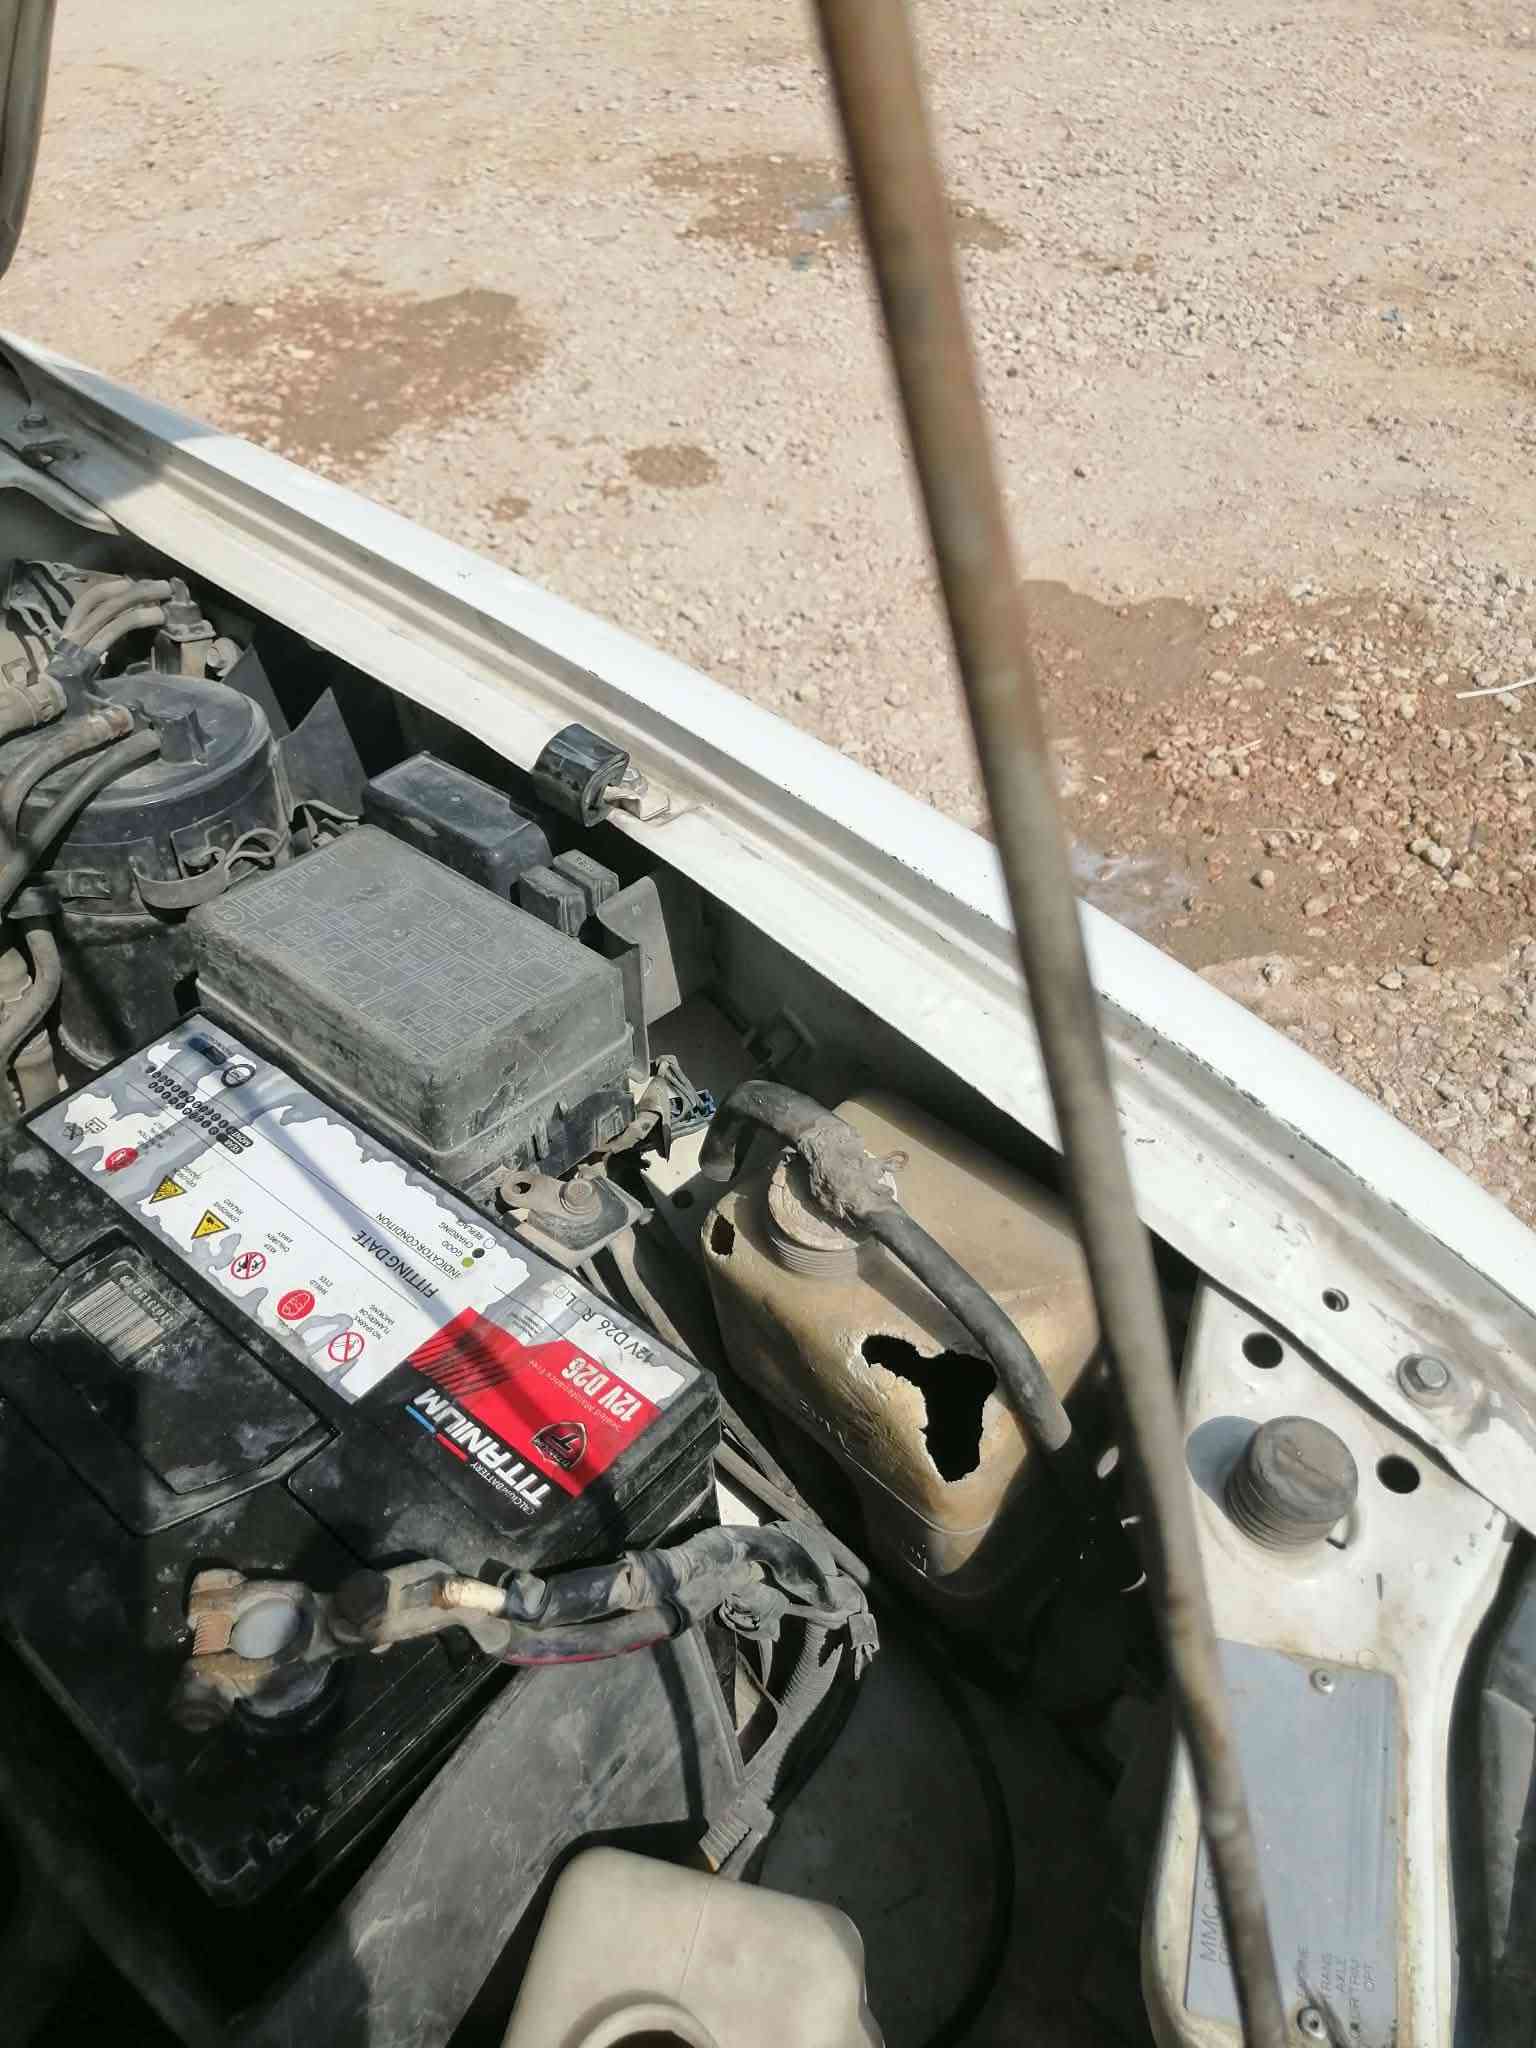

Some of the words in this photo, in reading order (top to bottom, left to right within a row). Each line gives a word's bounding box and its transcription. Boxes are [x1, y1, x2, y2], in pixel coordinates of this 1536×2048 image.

[350, 1228, 390, 1260] DATE
[375, 1212, 420, 1247] CONDITION
[436, 1221, 475, 1249] CHARGING
[415, 1243, 461, 1278] INDICATOR
[439, 1239, 464, 1257] GOOD
[382, 1253, 439, 1298] FITTING
[595, 1318, 630, 1345] D26
[624, 1338, 656, 1364] 12V
[558, 1354, 611, 1397] D26
[595, 1382, 646, 1424] 12V
[410, 1385, 555, 1507] TITANIUM
[468, 1459, 505, 1490] BATTERY
[1199, 1904, 1219, 1962] MMC
